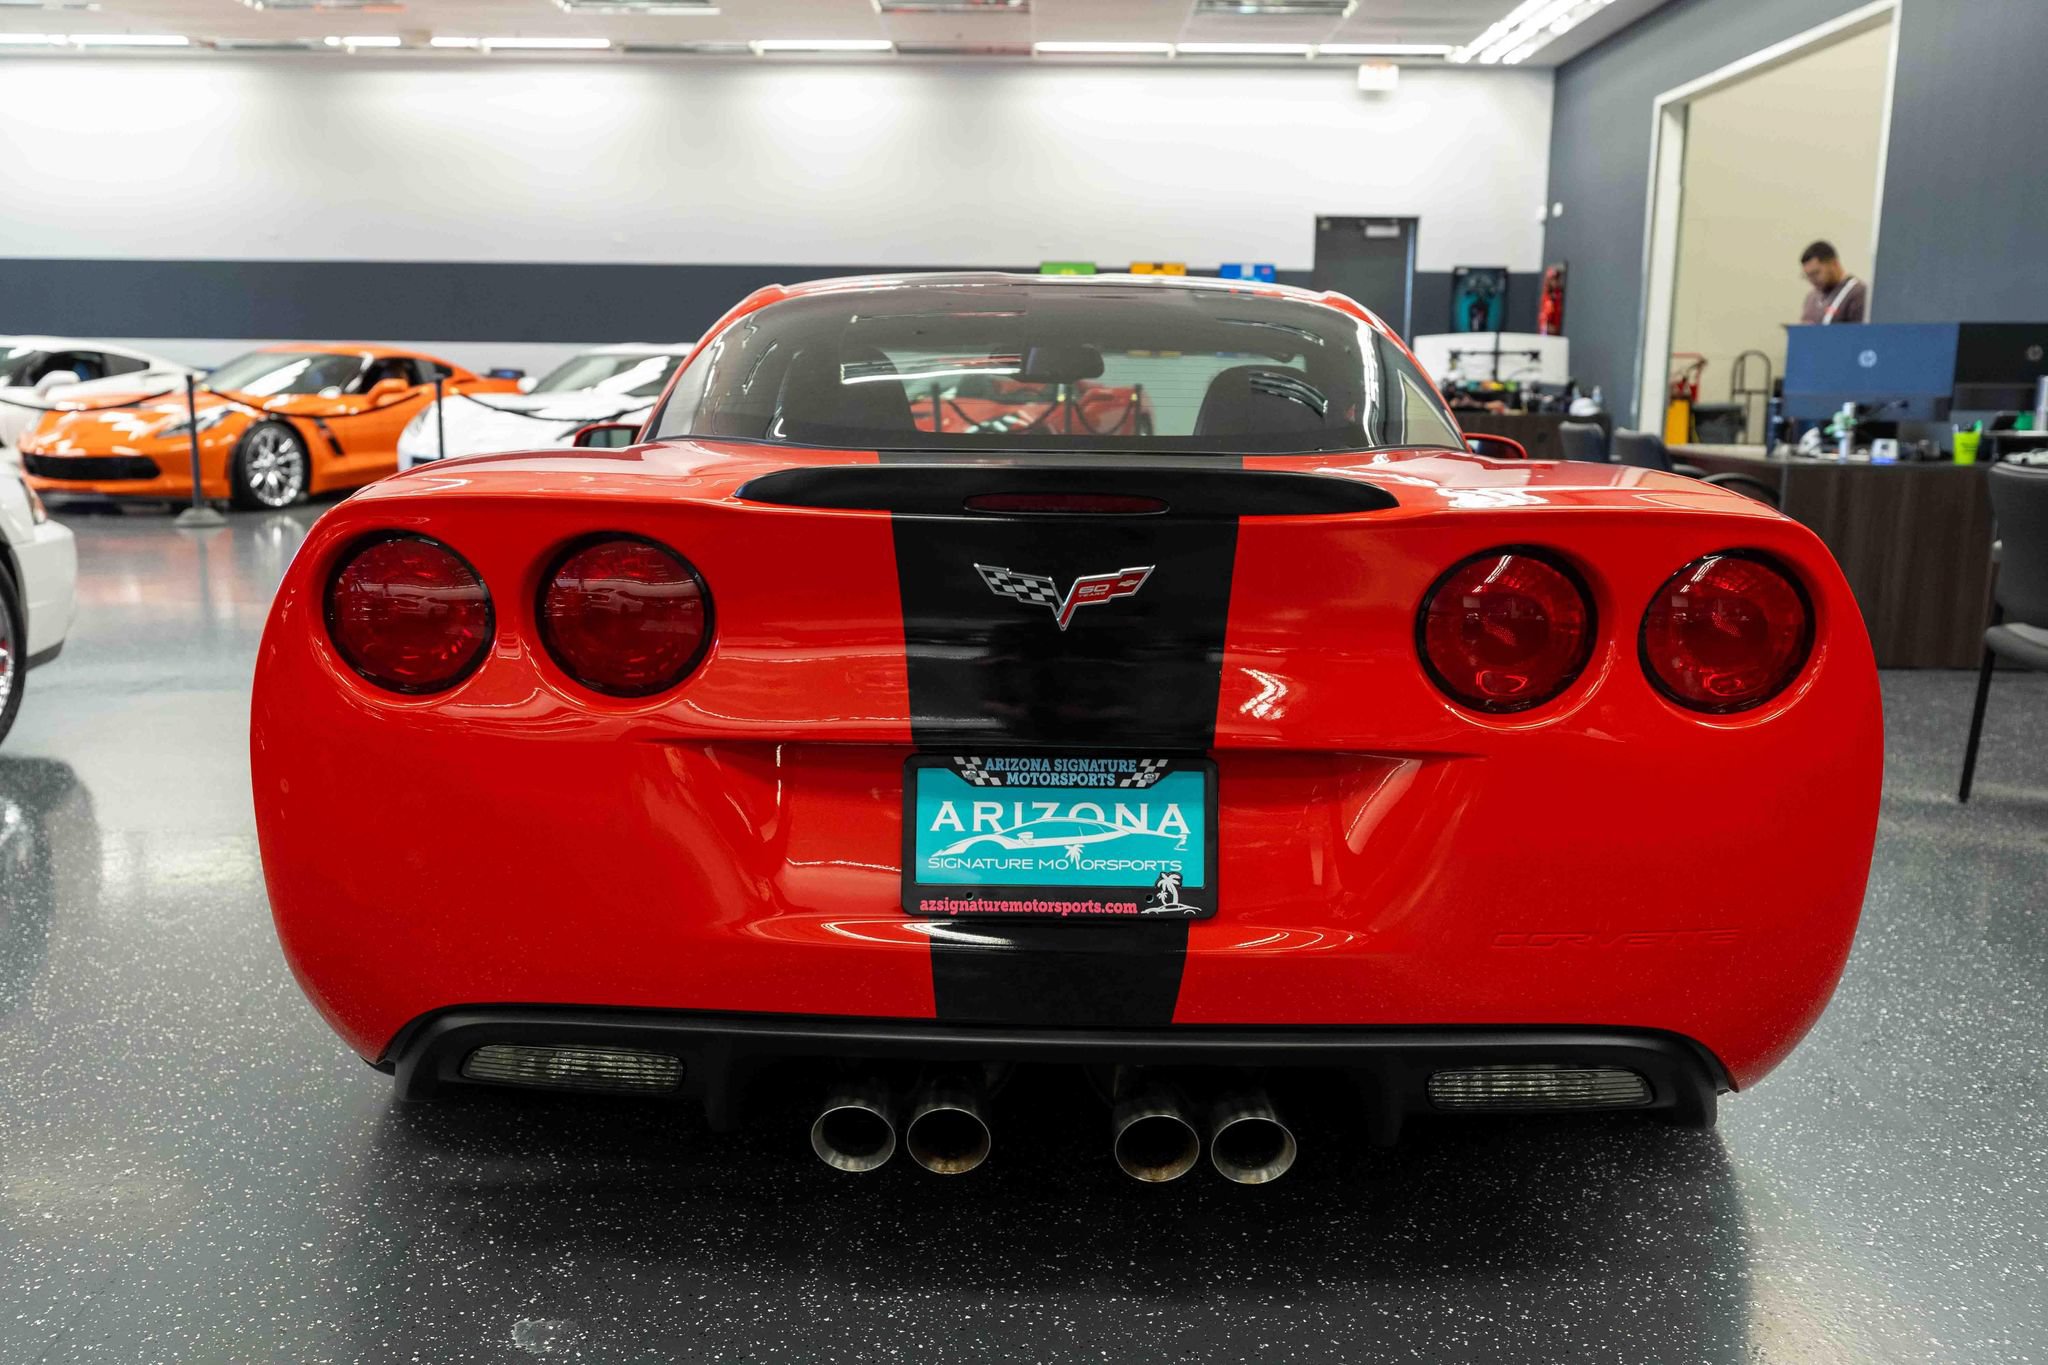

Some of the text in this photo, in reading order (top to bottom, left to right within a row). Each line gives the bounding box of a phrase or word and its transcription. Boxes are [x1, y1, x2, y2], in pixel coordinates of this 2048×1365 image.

[985, 758, 1137, 773] ARIZONA SIGNATURE
[1006, 772, 1115, 786] MOTORSPORTS
[929, 801, 1191, 834] ARIZONA
[928, 857, 1183, 872] SIGNATURE MOTORSPORTS
[920, 899, 1138, 916] azsignaturemotorsports.com
